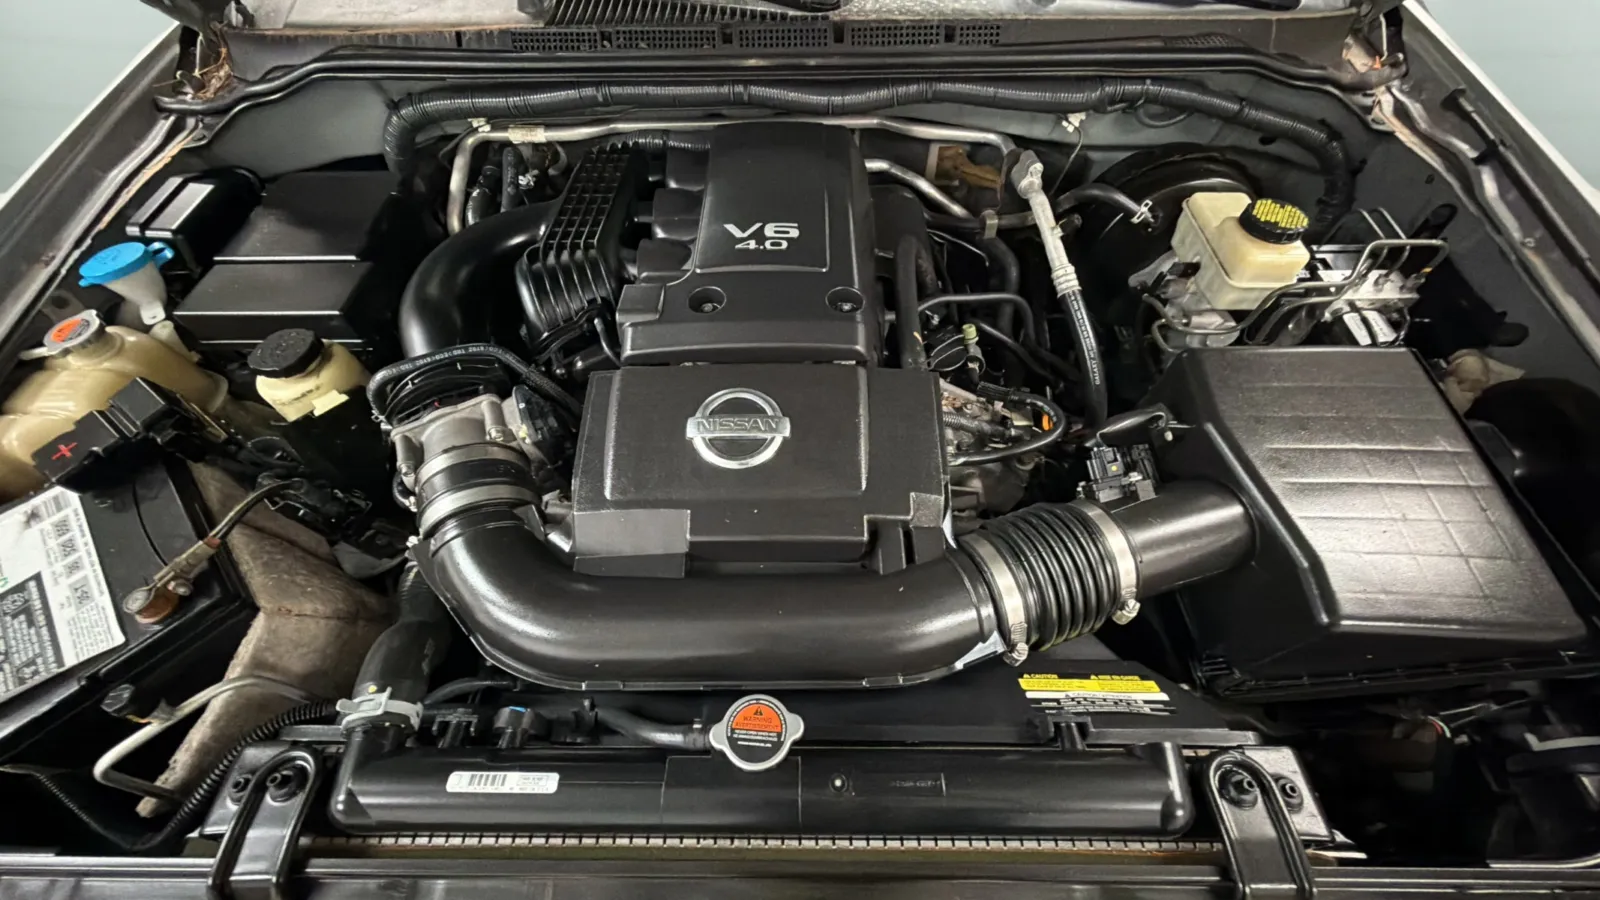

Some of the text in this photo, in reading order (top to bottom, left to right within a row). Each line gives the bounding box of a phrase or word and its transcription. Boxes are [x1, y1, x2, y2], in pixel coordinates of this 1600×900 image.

[723, 222, 800, 238] V6
[735, 239, 788, 250] 4.0
[697, 417, 780, 431] NISSAN
